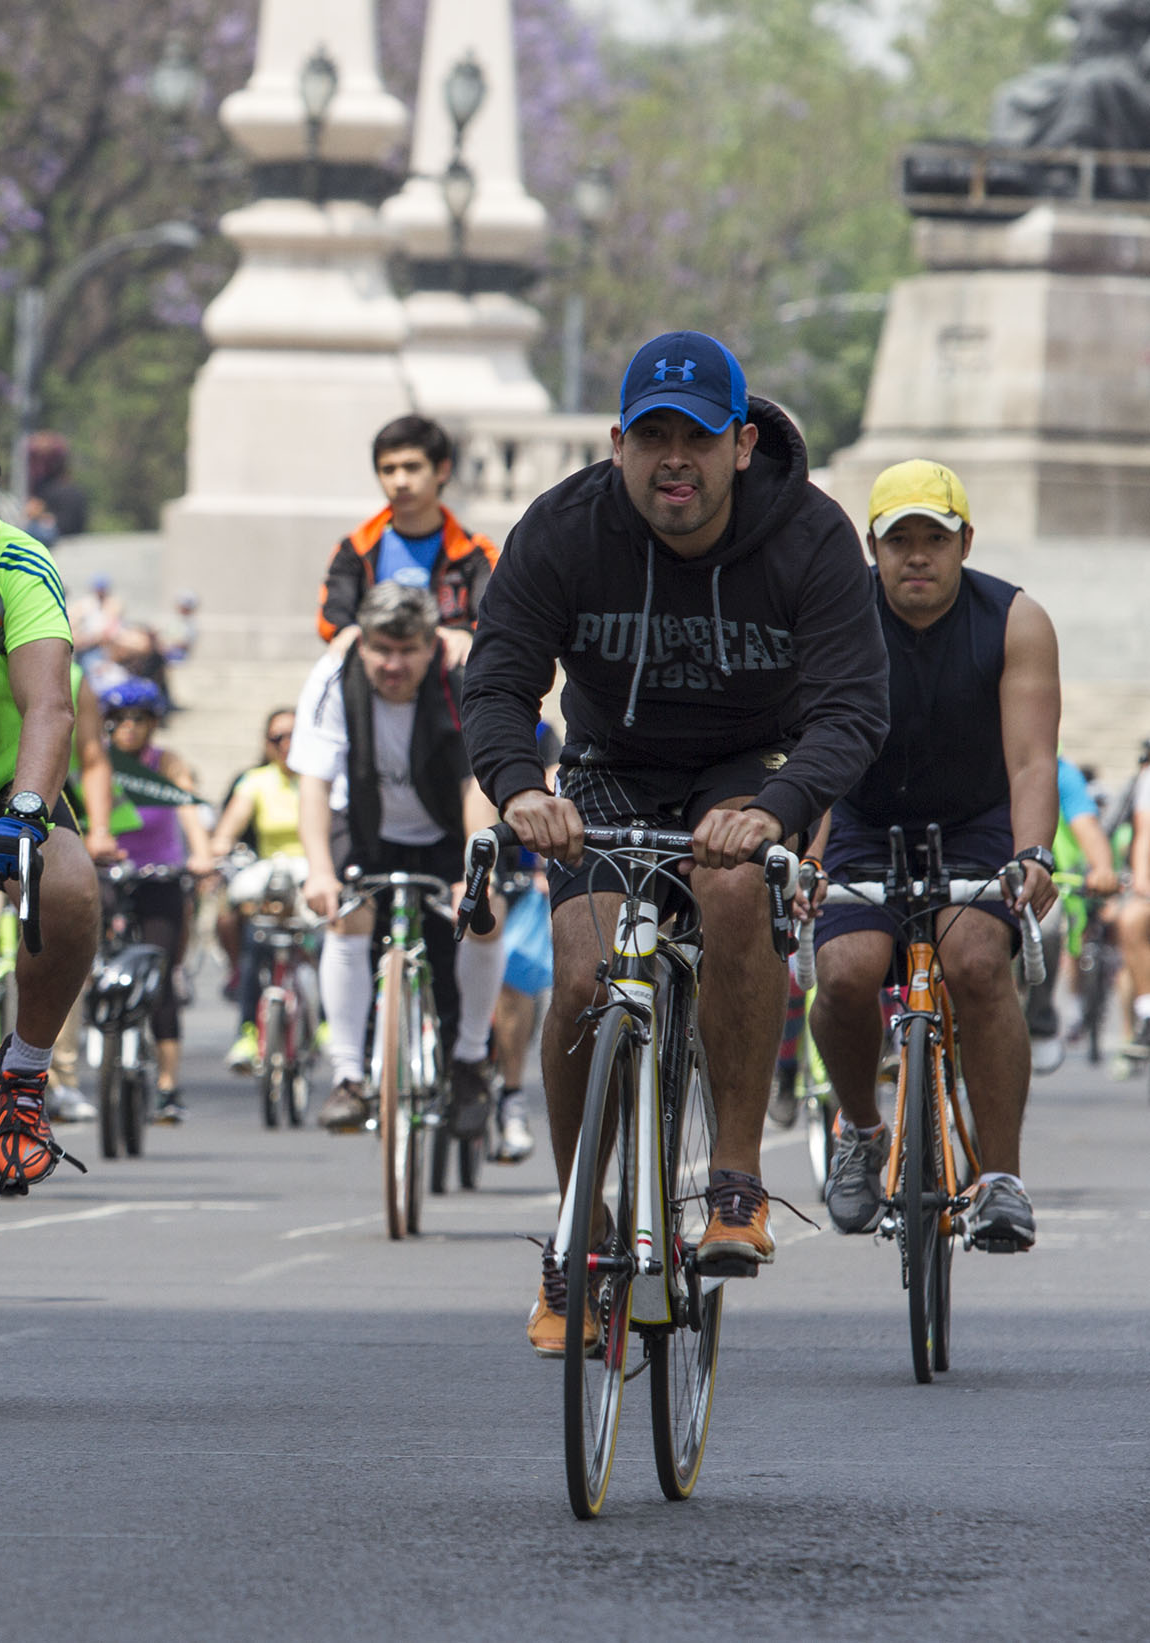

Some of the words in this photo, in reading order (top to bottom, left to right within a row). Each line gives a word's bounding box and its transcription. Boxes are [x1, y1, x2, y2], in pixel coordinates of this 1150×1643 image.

[646, 662, 724, 691] 1991
[469, 864, 484, 896] SRAM
[773, 884, 784, 916] SRAM
